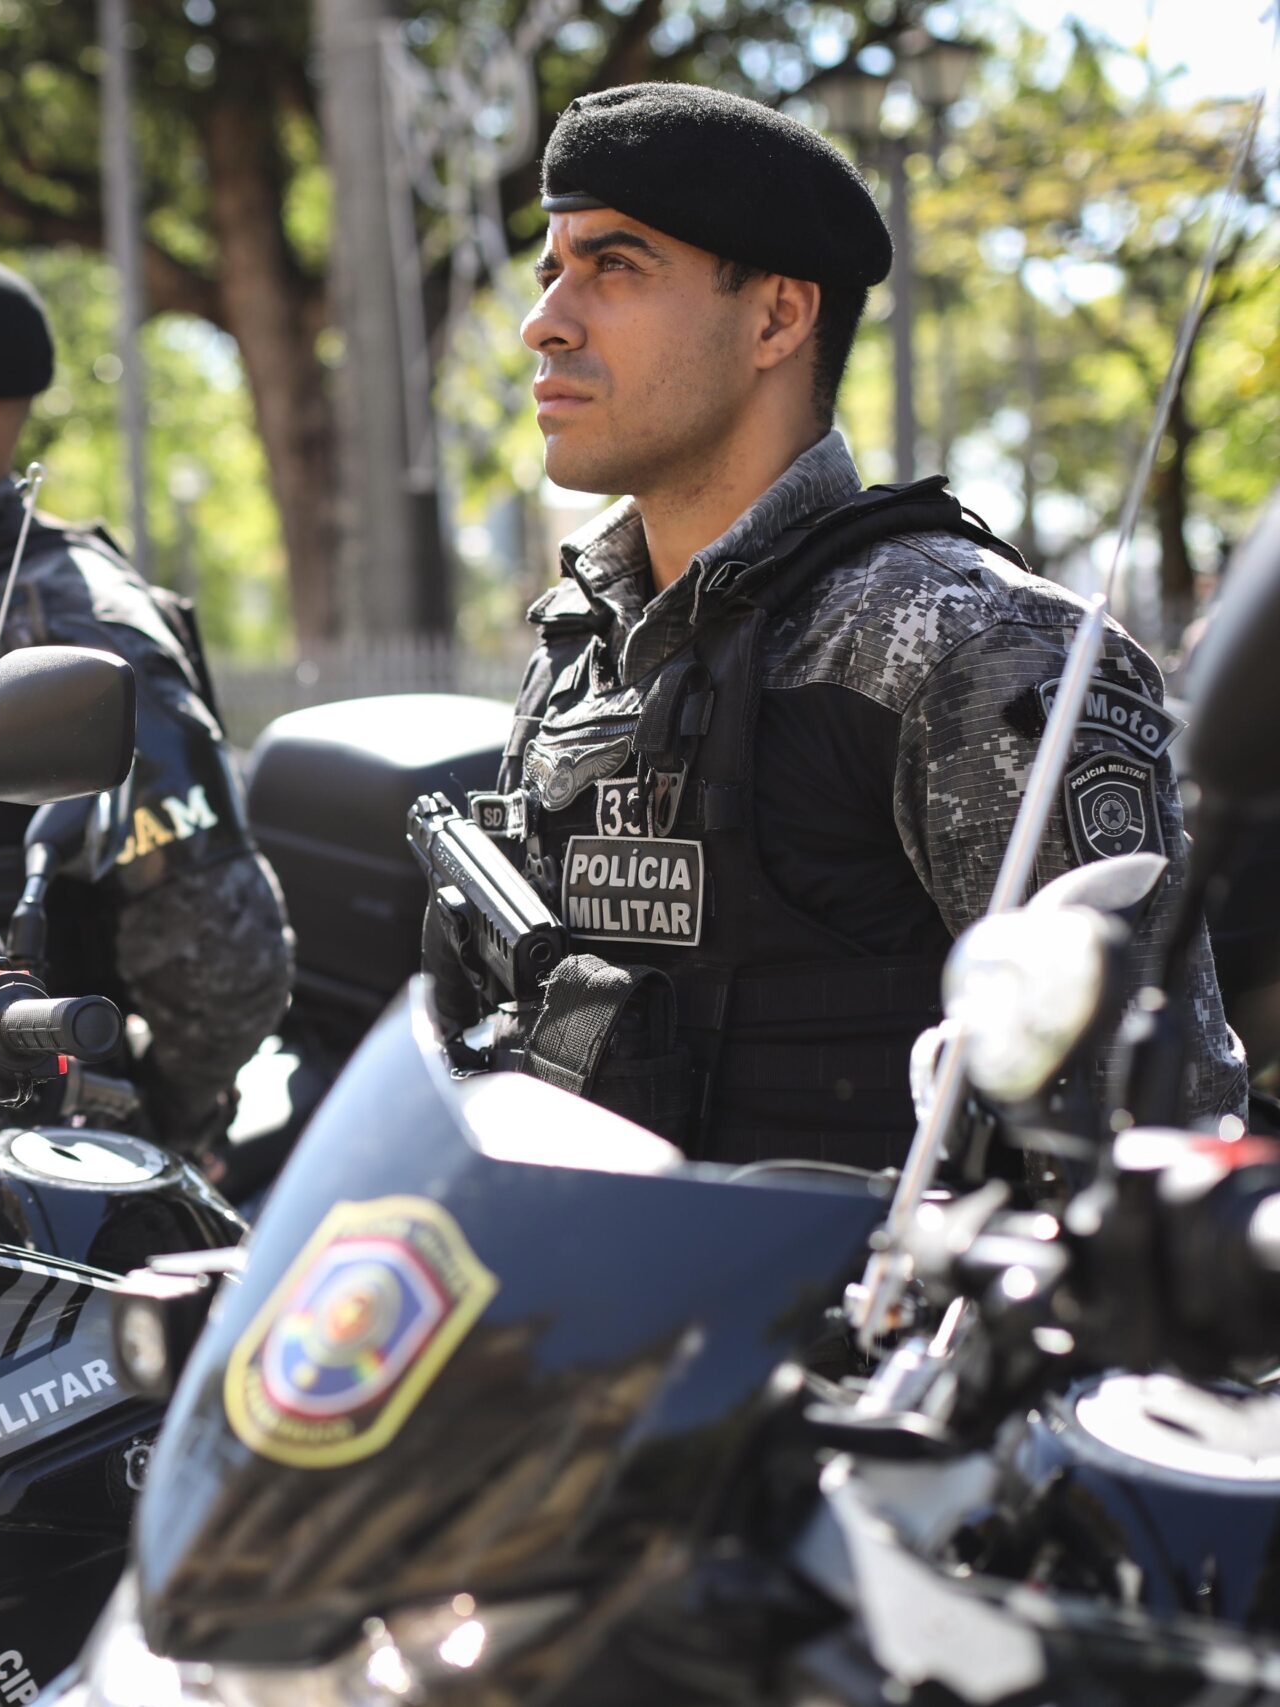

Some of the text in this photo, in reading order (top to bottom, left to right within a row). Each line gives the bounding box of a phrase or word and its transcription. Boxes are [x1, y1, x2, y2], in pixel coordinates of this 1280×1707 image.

[1071, 764, 1147, 790] POLÍCIA MILITAR
[483, 807, 503, 827] SD
[570, 848, 692, 891] POLÍCIA
[569, 896, 692, 935] MILITAR
